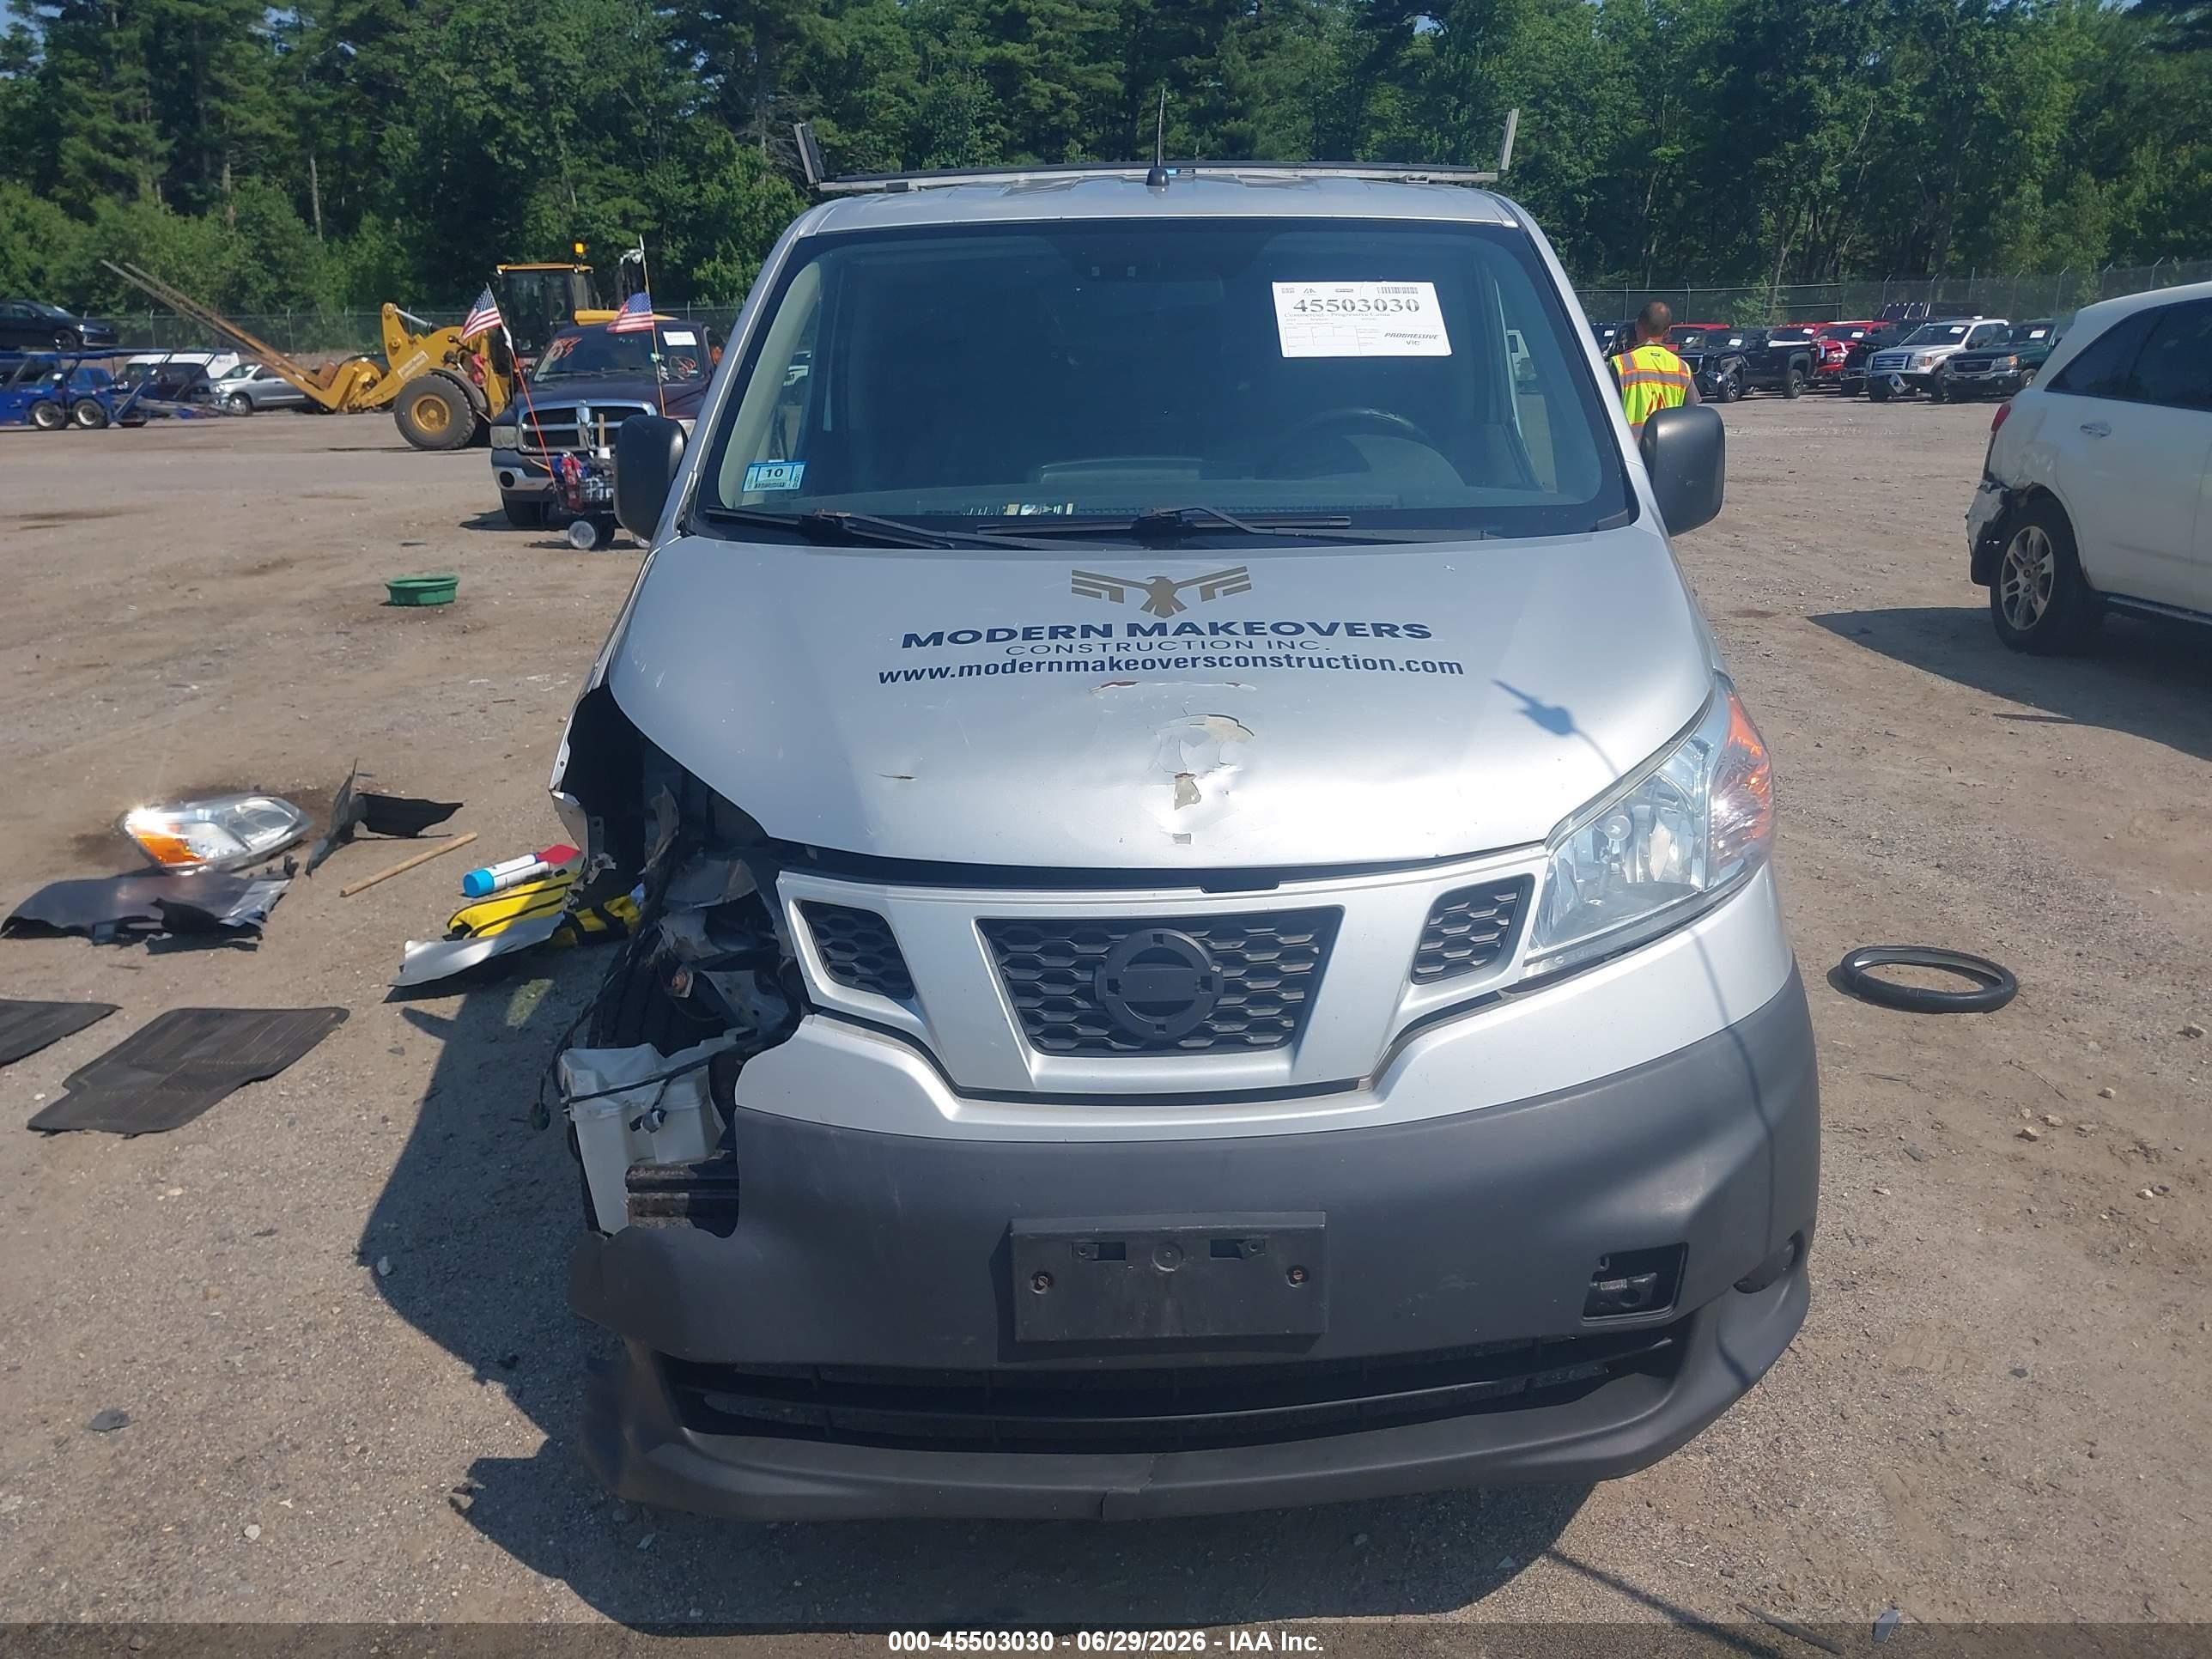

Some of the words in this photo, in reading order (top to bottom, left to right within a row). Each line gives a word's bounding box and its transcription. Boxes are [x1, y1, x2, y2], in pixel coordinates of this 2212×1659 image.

[1293, 299, 1420, 313] 45503030
[766, 468, 783, 477] 10
[902, 623, 1113, 649] MODERN
[1126, 621, 1432, 639] MAKEOVERS
[1006, 641, 1257, 655] CONSTRUCTION
[1267, 641, 1330, 652] INC.
[878, 654, 1465, 684] www.modernmakeoversconstruction.com
